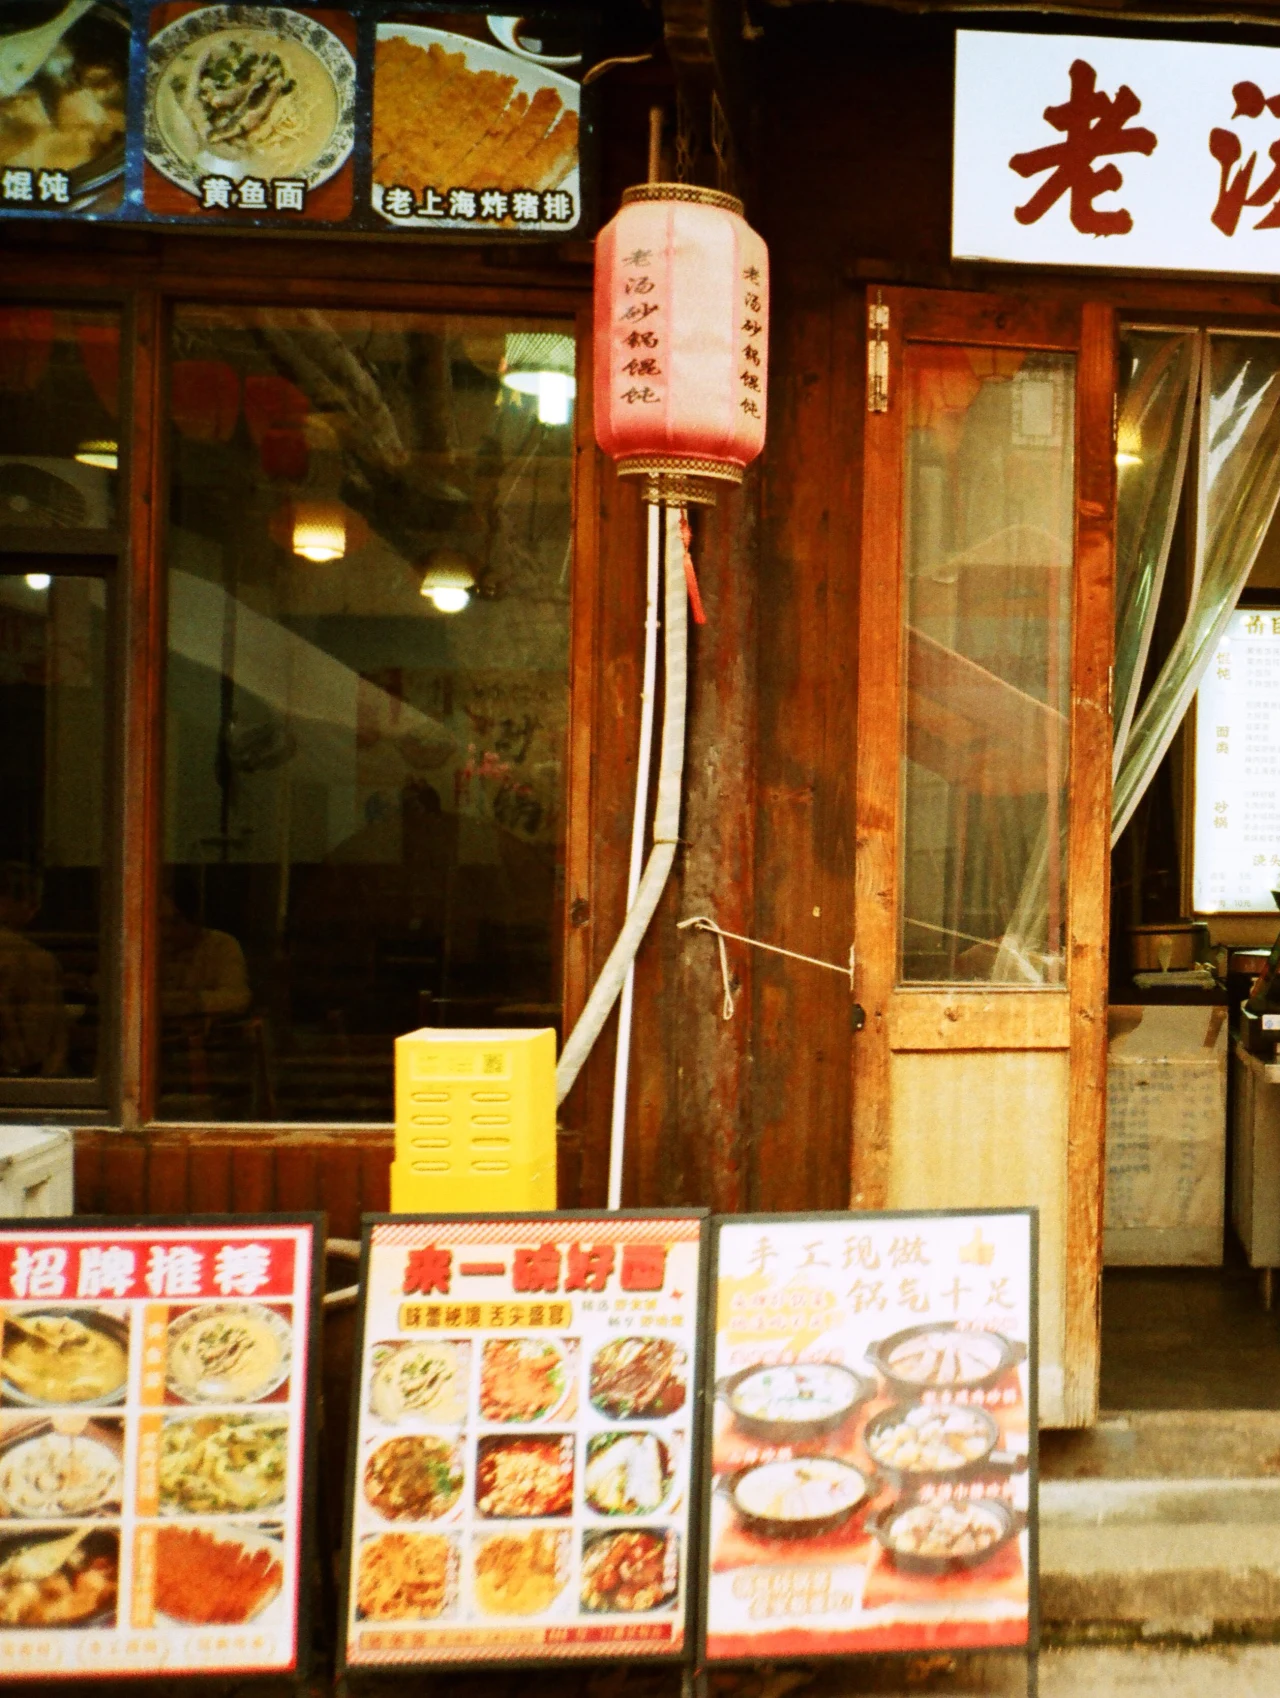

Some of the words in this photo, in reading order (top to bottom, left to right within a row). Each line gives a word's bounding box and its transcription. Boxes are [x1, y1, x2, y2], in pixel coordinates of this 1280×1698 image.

[2, 171, 70, 202] 馄饨
[202, 178, 306, 211] 黄鱼面
[385, 189, 572, 219] 老上海炸猪排
[10, 1243, 271, 1298] 招牌推荐
[749, 1235, 932, 1273] 手工现做
[847, 1275, 1016, 1314] 锅气十足
